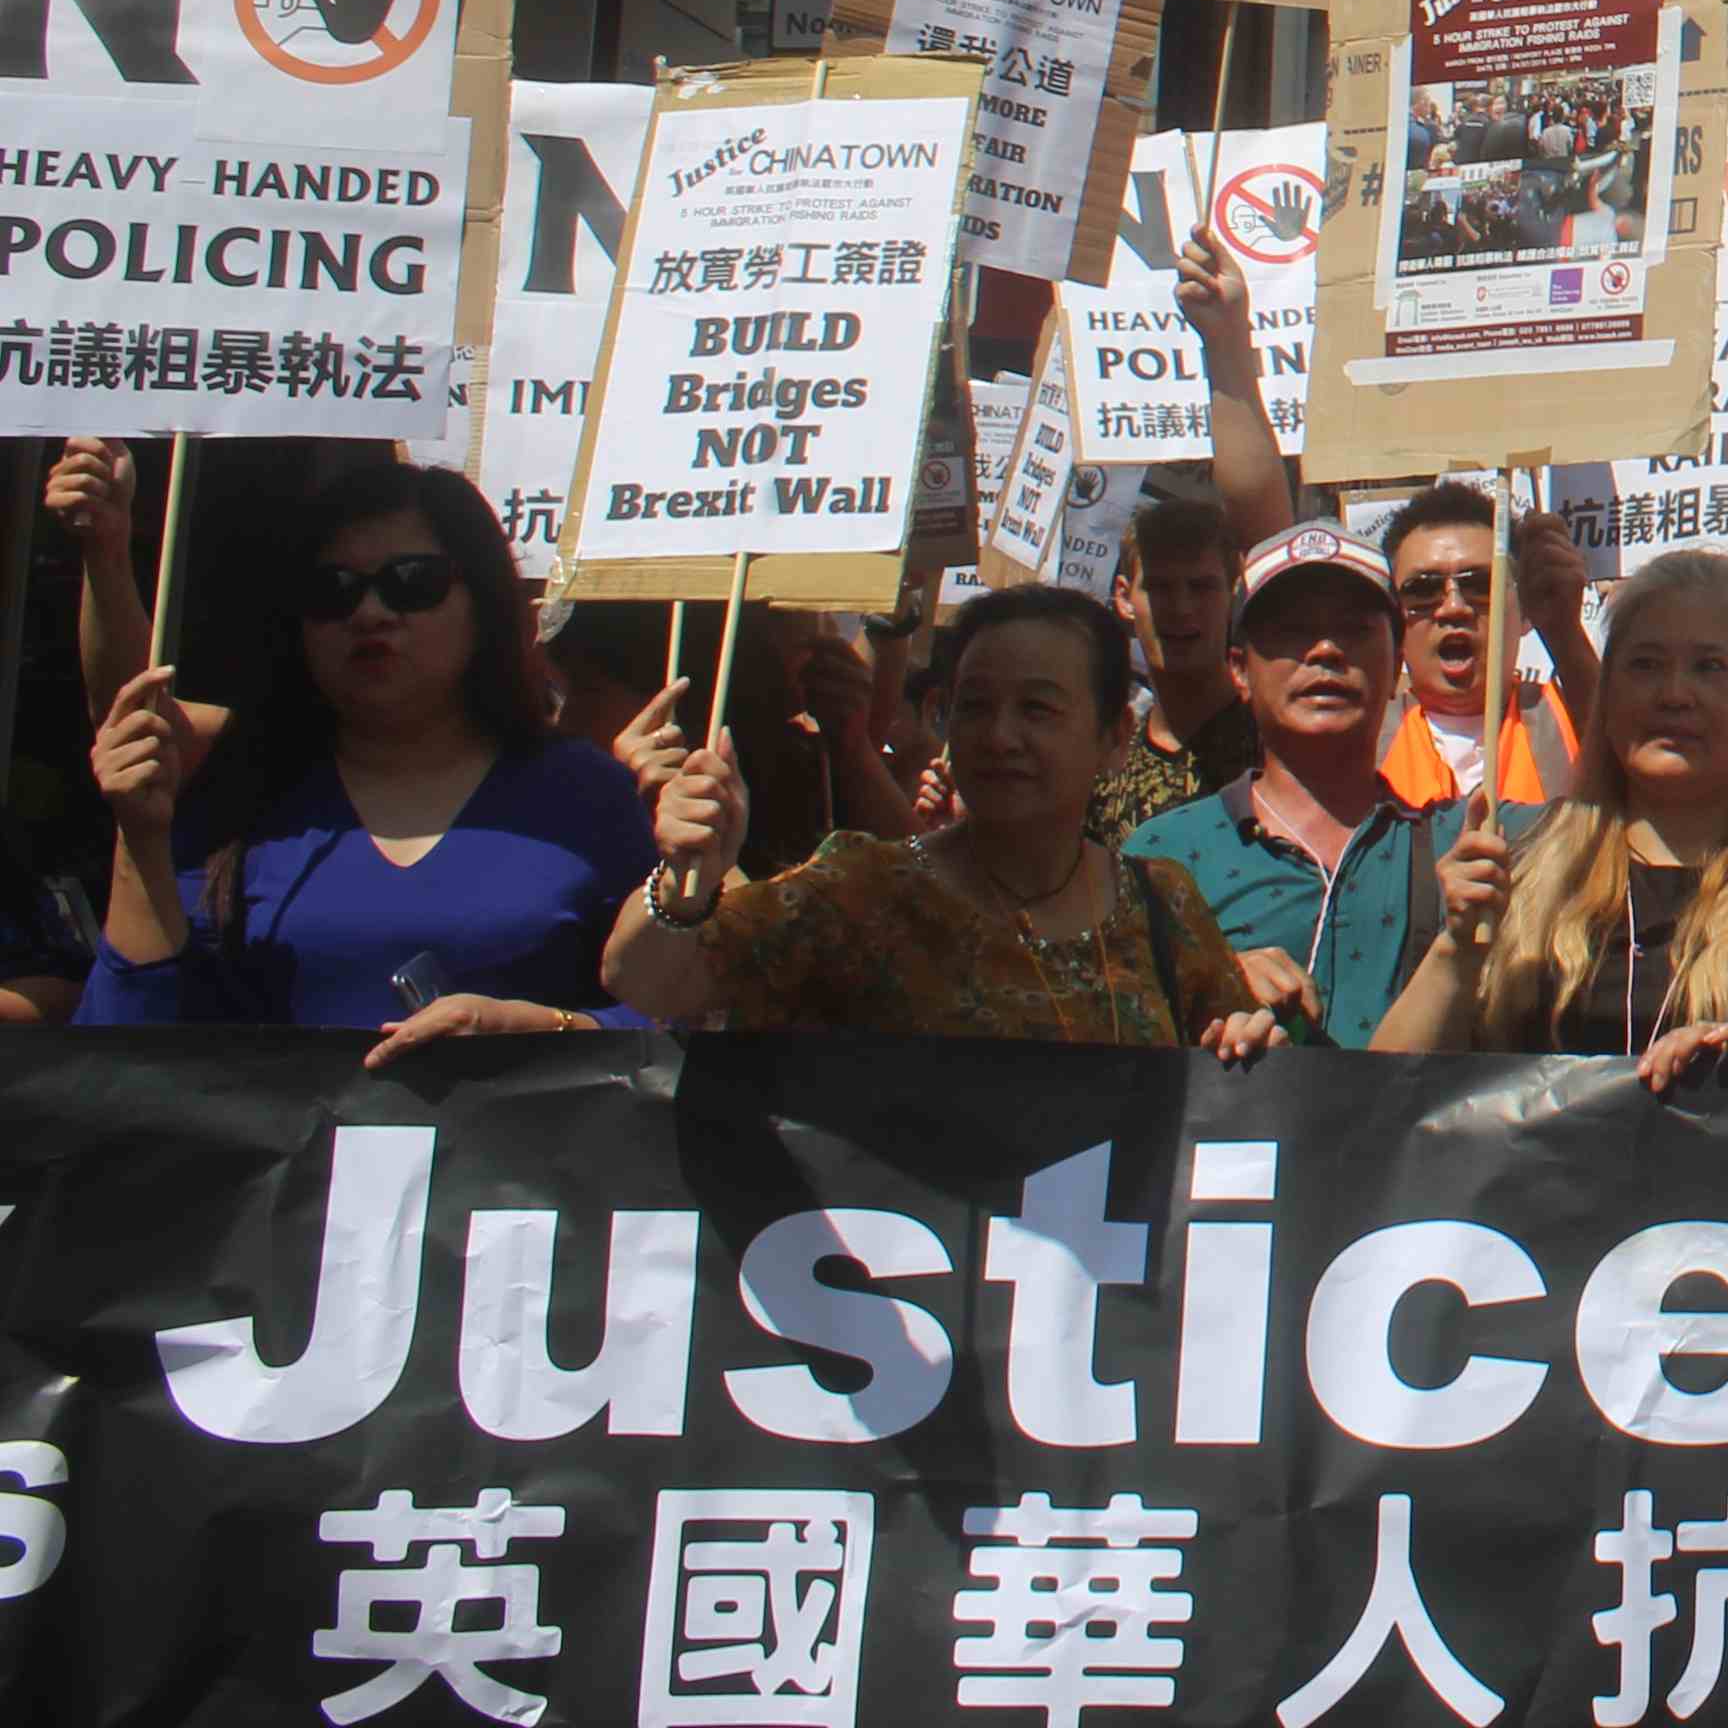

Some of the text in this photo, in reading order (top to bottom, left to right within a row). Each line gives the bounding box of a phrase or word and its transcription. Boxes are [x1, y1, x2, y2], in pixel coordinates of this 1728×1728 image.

[666, 126, 767, 198] Justice
[750, 142, 939, 174] CHINATOWN
[973, 134, 1027, 166] FAIR
[0, 148, 441, 206] HEAVY HANDED
[968, 174, 1062, 214] RATION
[0, 216, 427, 296] POLICING
[648, 240, 927, 295] 放寬勞工簽證
[689, 311, 862, 357] BUILD
[663, 367, 868, 420] Bridges
[692, 424, 821, 468] NOT
[607, 477, 756, 520] Brexit
[774, 476, 893, 516] Wall
